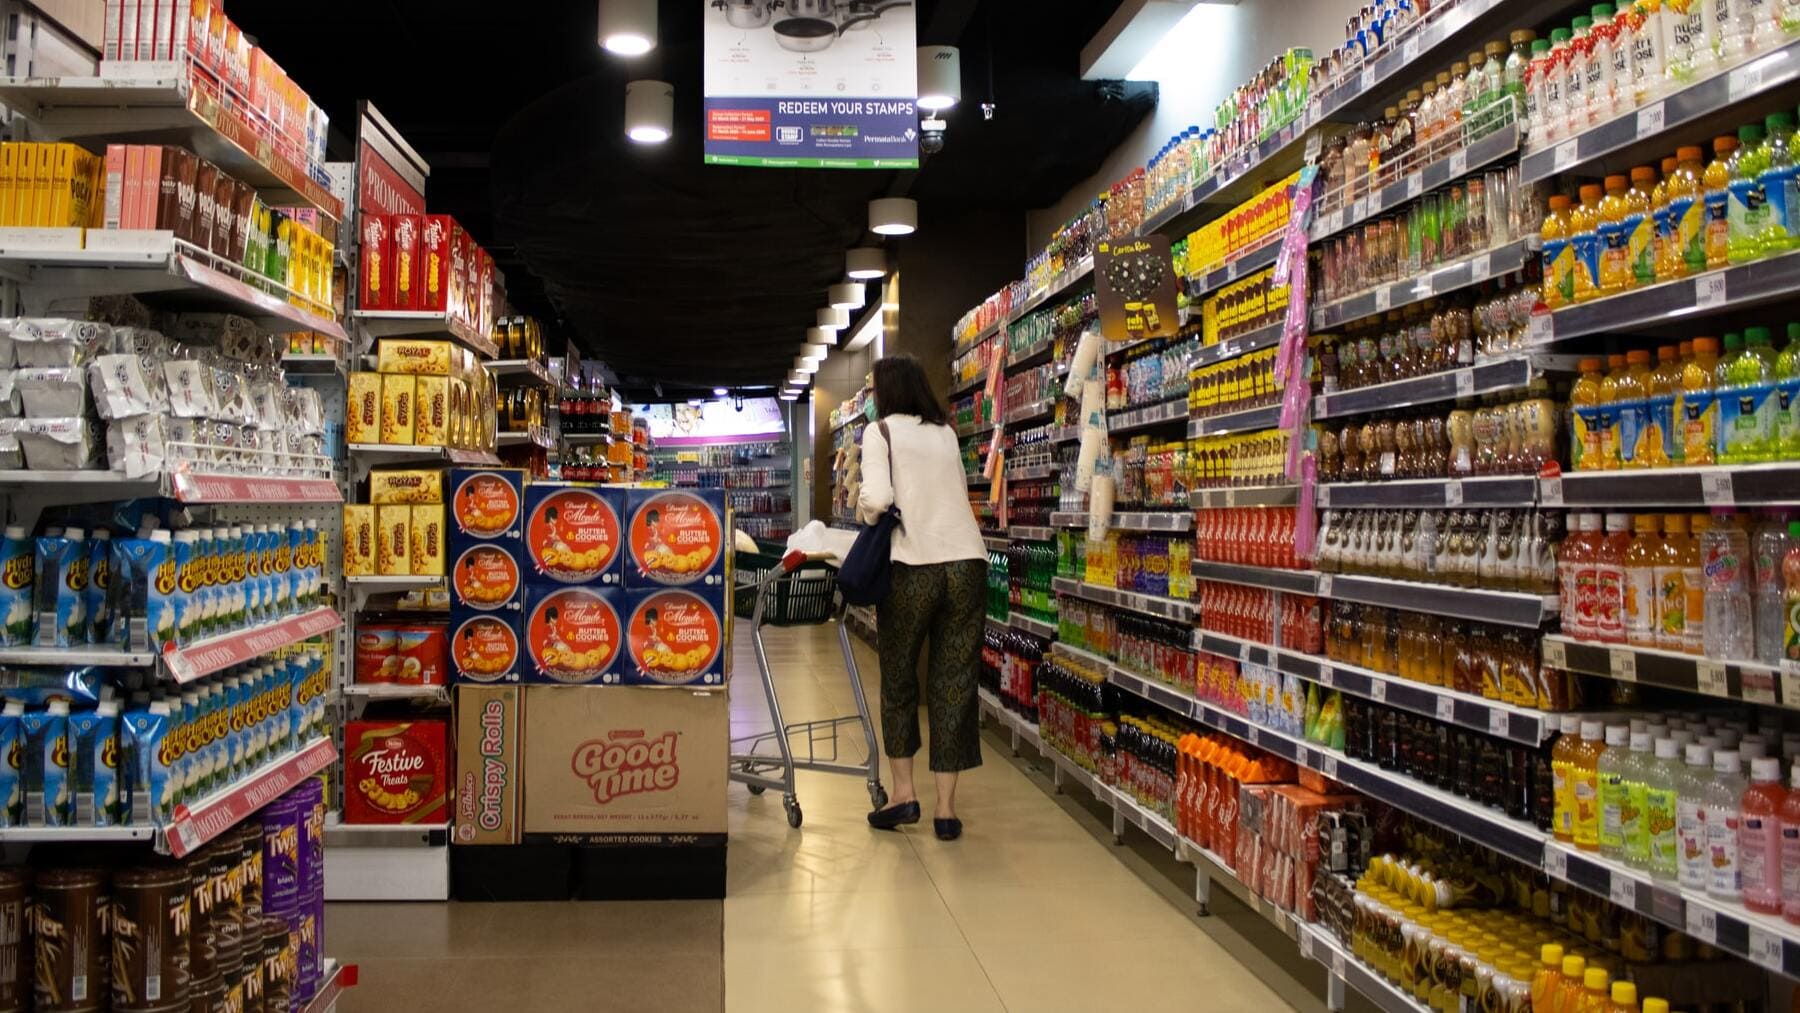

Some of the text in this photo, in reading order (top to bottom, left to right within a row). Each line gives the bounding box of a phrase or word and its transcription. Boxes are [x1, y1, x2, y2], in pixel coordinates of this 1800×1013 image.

[779, 102, 913, 115] REDEEM YOUR STAMPS
[563, 509, 602, 523] Monde
[665, 512, 701, 526] Monde
[563, 609, 601, 623] Monde
[663, 610, 700, 625] Monde
[572, 731, 677, 778] Good
[362, 749, 424, 776] Festive
[480, 700, 506, 830] Crispy Rolls
[244, 770, 290, 808] PROMOTION
[296, 745, 333, 776] PROMOTION
[381, 774, 408, 786] Treats
[588, 764, 679, 804] Time
